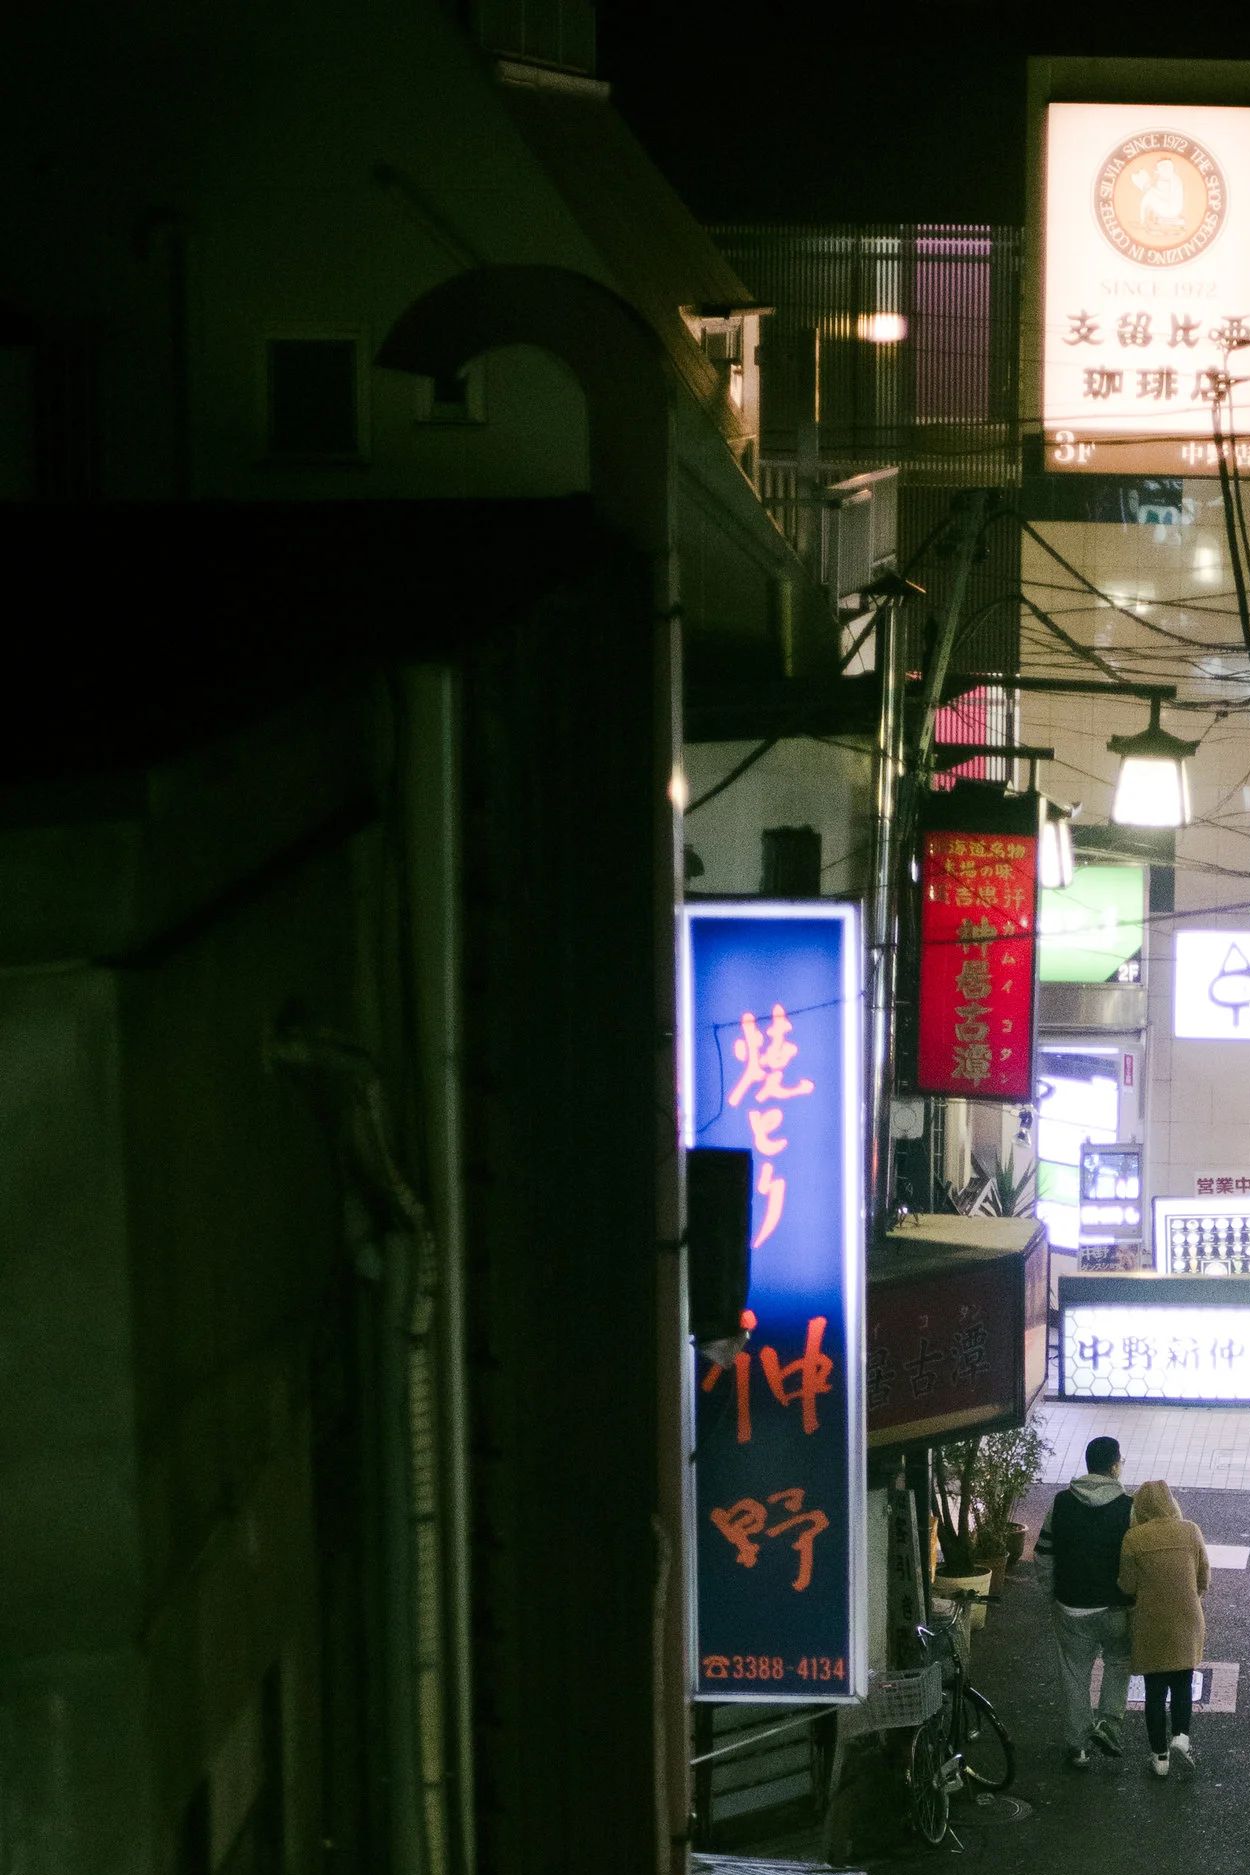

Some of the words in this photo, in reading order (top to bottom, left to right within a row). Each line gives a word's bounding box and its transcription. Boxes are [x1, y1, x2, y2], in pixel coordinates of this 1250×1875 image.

[1122, 134, 1161, 159] SINCE
[1163, 134, 1189, 153] 1972
[1190, 146, 1214, 176] THE
[1100, 158, 1125, 199] SILVIA
[1205, 175, 1222, 211] SHOP
[1100, 200, 1130, 249] COFFEE
[1147, 211, 1219, 265] SPECIALIZING
[1127, 243, 1146, 262] IN
[1101, 281, 1162, 298] SINCE
[1175, 281, 1218, 298] 1972
[1083, 364, 1230, 401] 珈琲店
[1054, 431, 1096, 464] 3F
[1117, 963, 1140, 982] 2F
[732, 1656, 845, 1682] 3388-4134
